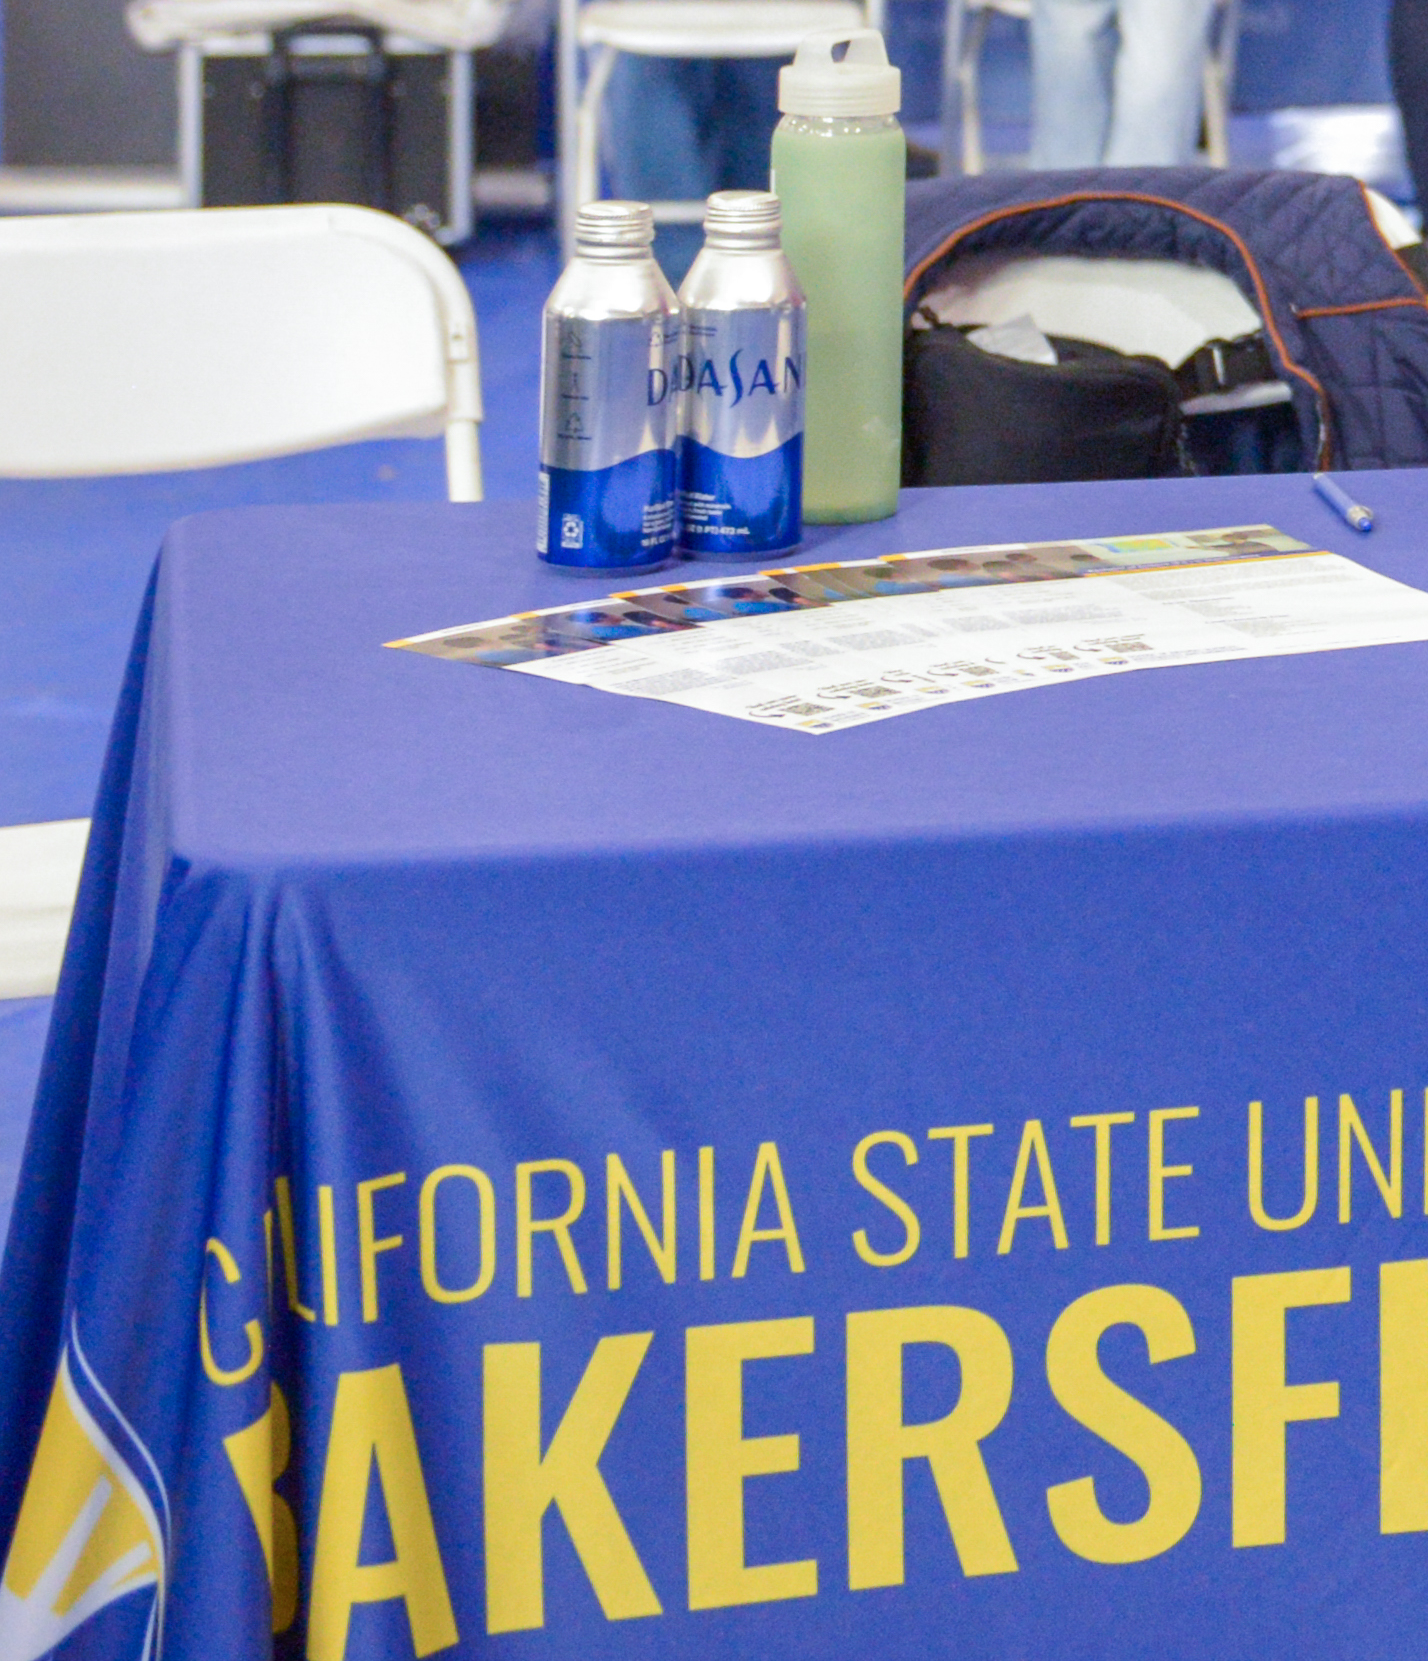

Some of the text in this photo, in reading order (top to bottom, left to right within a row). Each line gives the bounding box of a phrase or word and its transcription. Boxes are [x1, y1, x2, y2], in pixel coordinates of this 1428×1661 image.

[677, 348, 803, 409] DASAN
[200, 1132, 806, 1386] CLIFORNIA
[853, 1097, 1200, 1267] STATE
